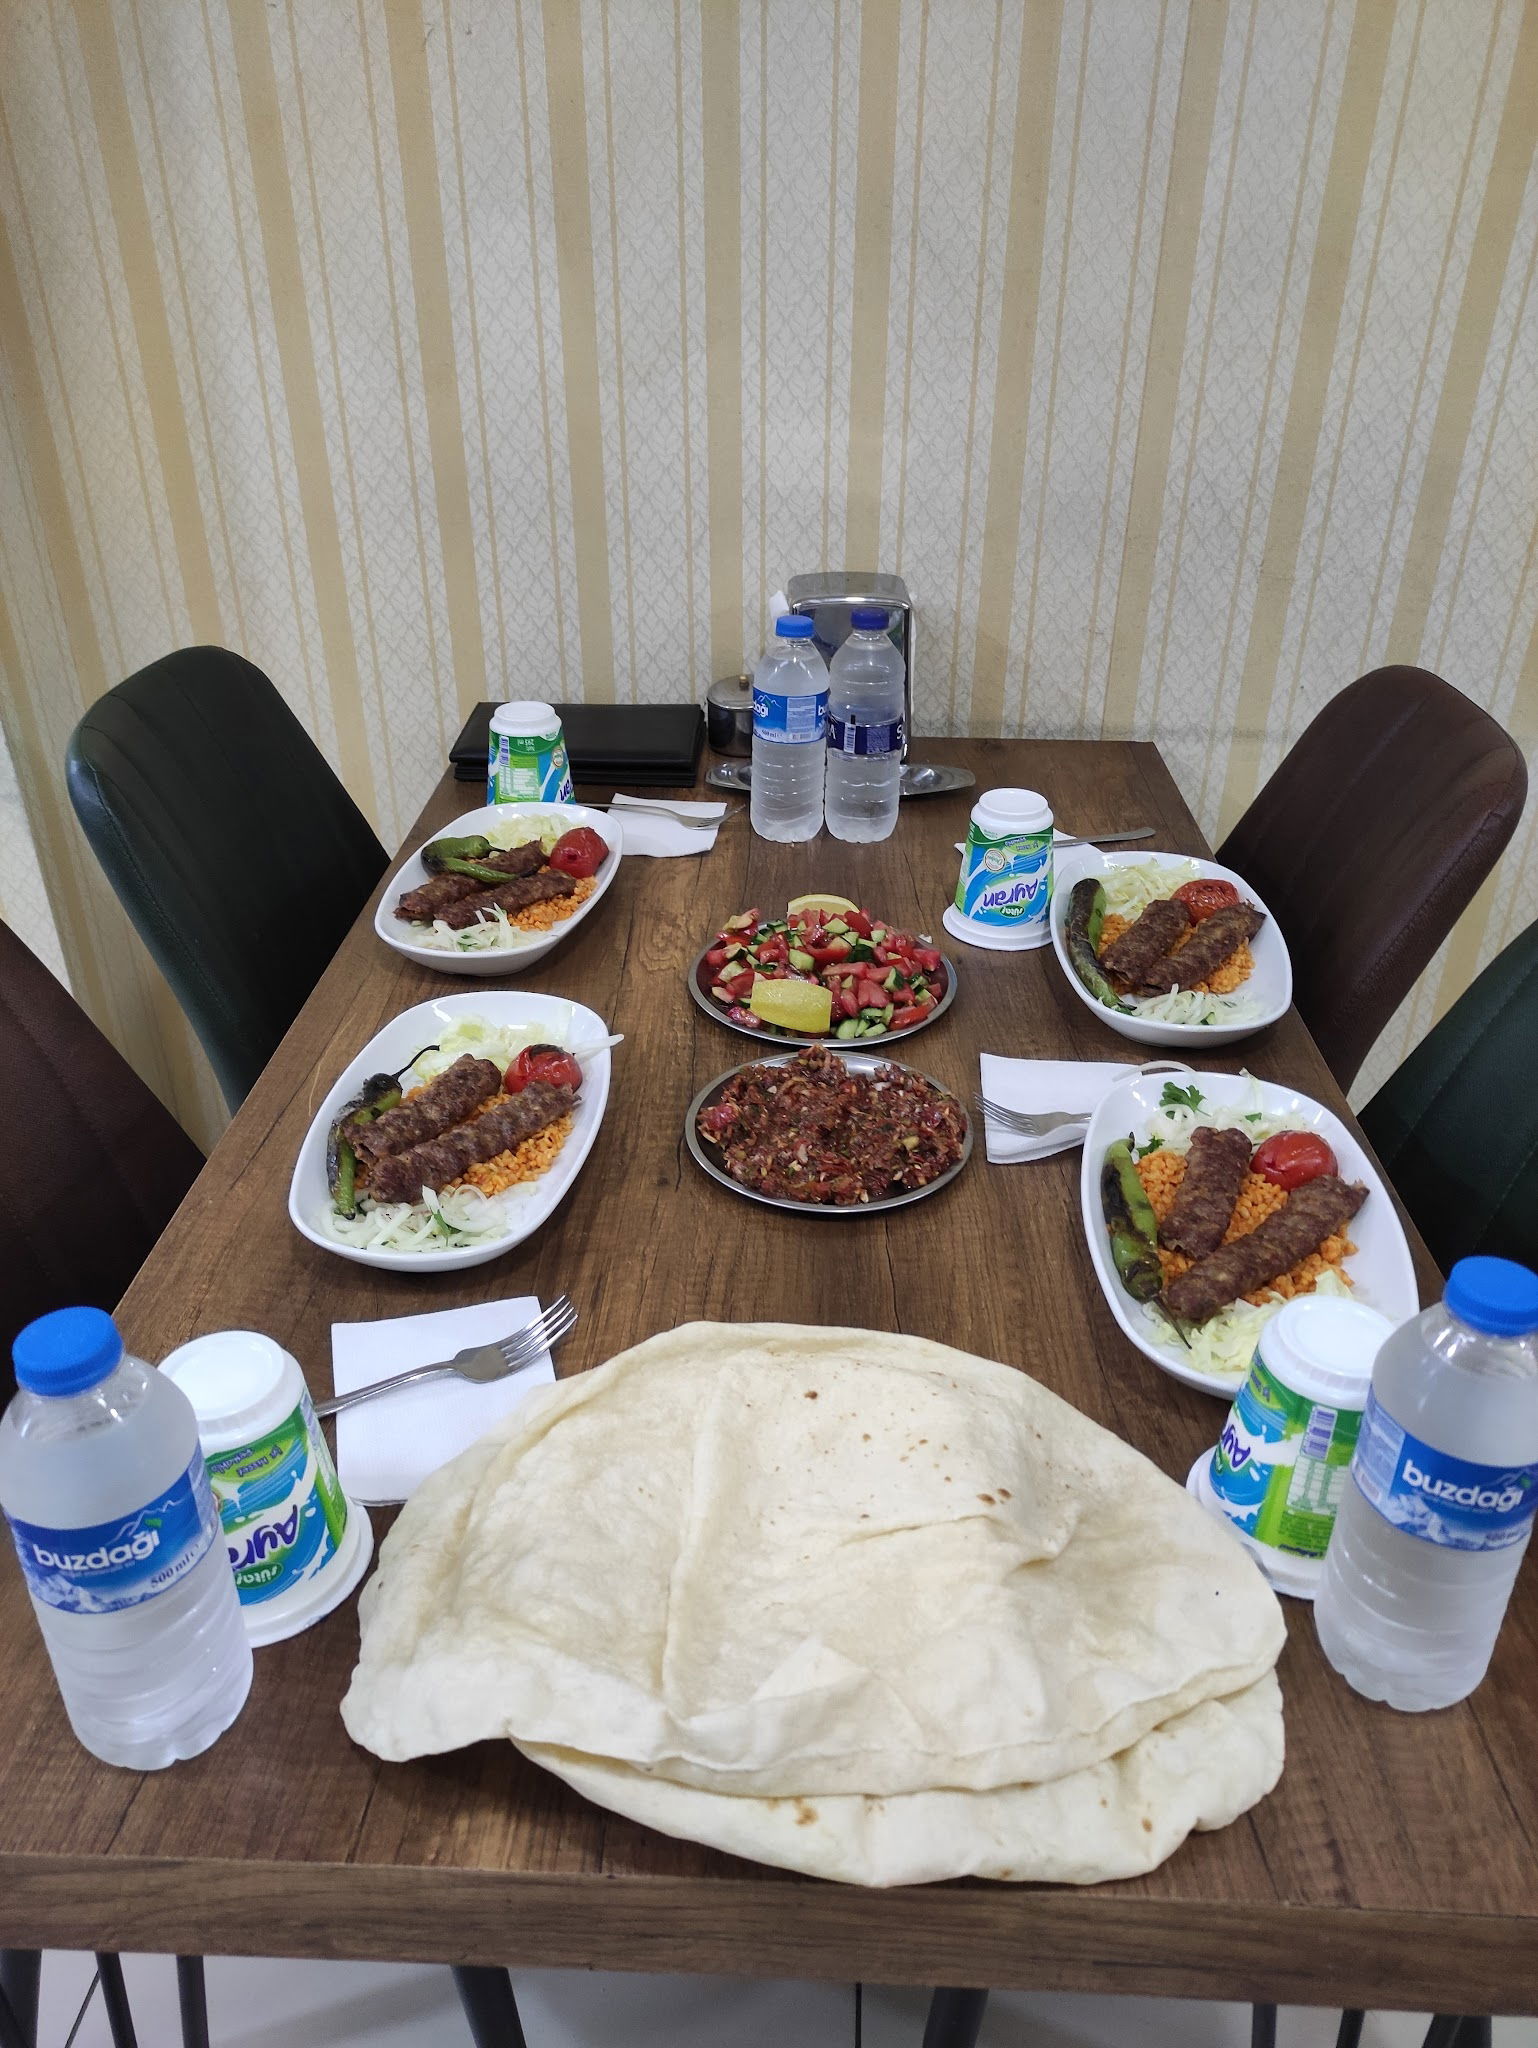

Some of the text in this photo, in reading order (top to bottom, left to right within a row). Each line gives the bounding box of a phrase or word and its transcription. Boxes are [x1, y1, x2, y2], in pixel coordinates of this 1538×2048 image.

[983, 879, 1039, 907] Ayran
[32, 1529, 160, 1571] buzdağı
[150, 1566, 175, 1588] 500
[175, 1553, 190, 1574] ml
